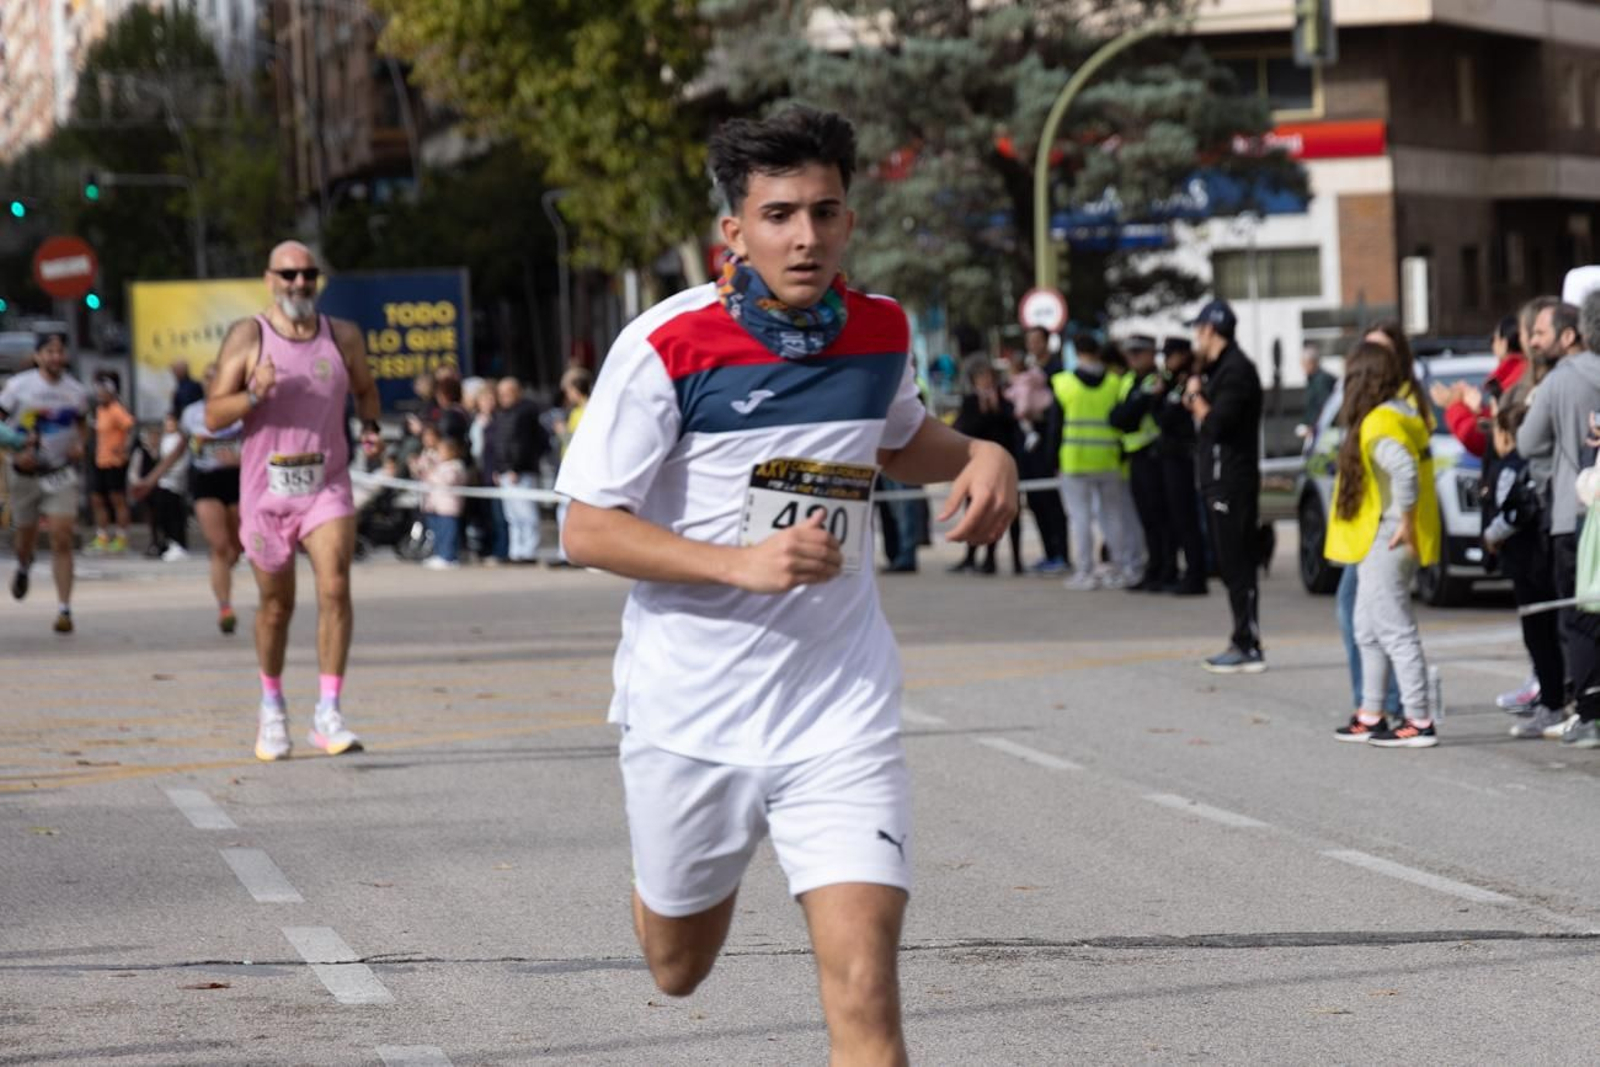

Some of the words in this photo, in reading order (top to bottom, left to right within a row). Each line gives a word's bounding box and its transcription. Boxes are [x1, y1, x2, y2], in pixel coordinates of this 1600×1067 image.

[383, 301, 456, 328] TODO
[367, 329, 401, 354] LO
[405, 327, 457, 353] QUE
[366, 352, 458, 379] CESITAS
